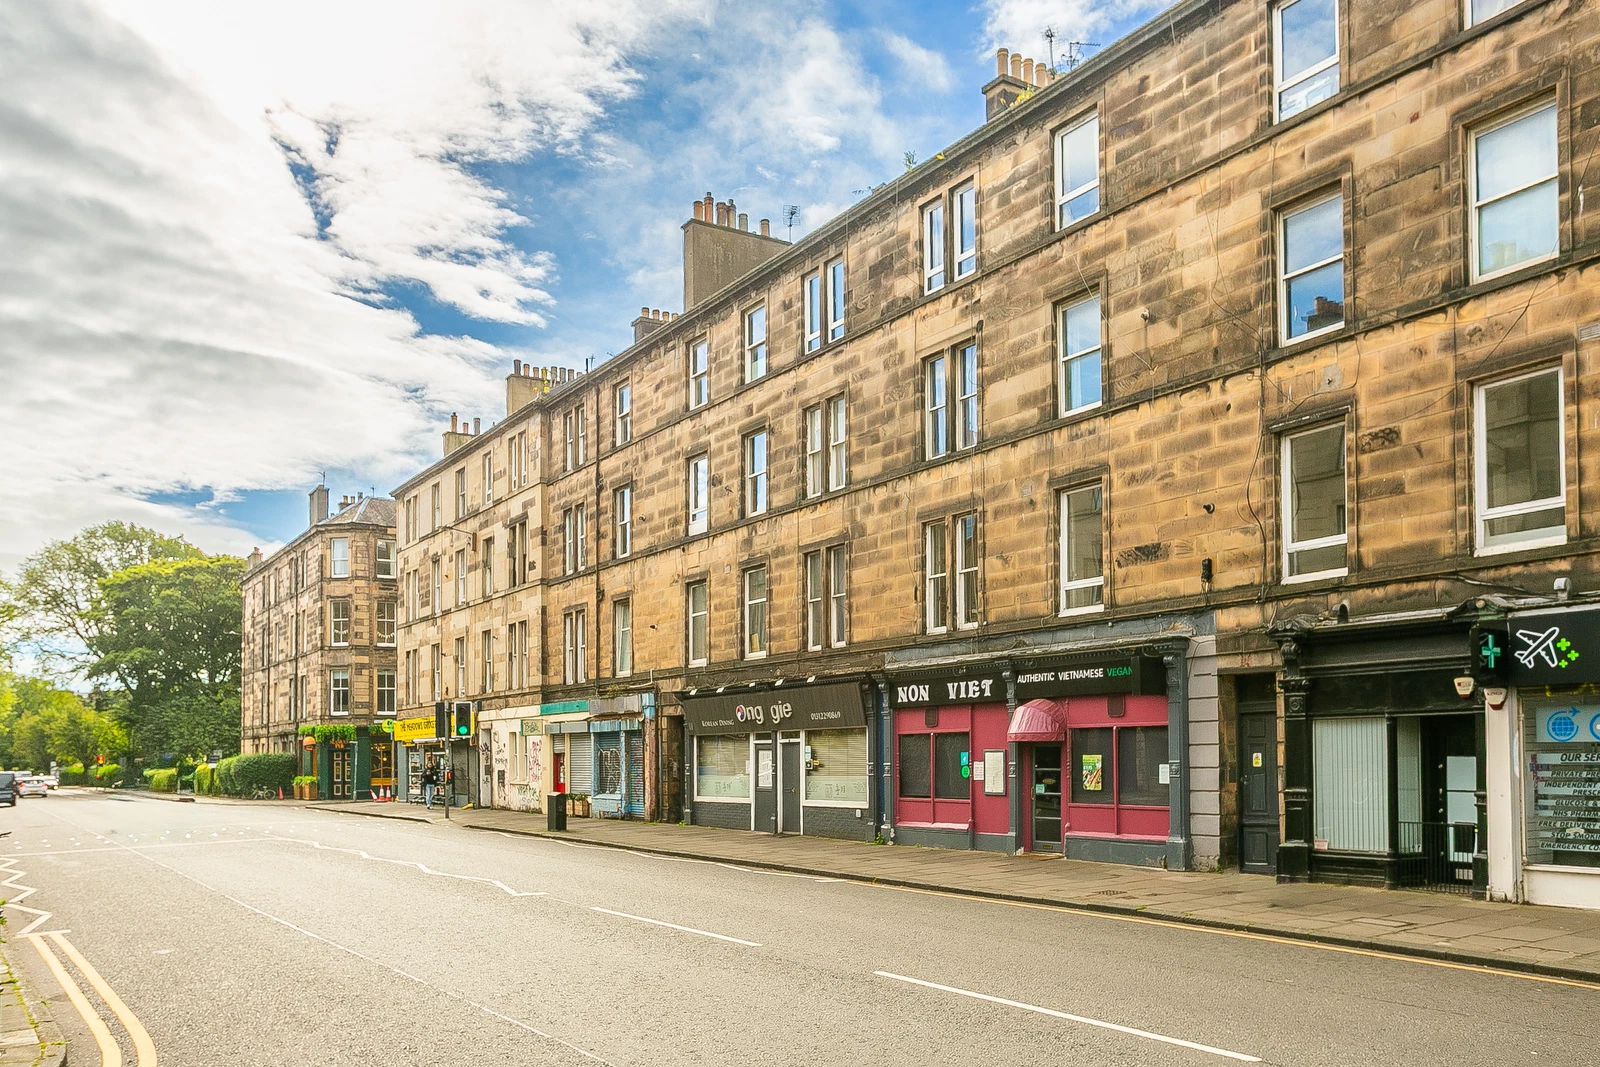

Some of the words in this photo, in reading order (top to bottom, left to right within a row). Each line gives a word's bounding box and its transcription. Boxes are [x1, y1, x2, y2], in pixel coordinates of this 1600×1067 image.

[1017, 672, 1055, 684] AUTHENTIC
[1058, 668, 1104, 681] VIETNAMESE
[897, 684, 930, 703] NON
[947, 679, 993, 700] VIET
[736, 704, 764, 725] Ong
[770, 700, 793, 724] gie
[1560, 753, 1582, 762] OUR
[1555, 799, 1590, 807] GLUCOSE
[1551, 831, 1571, 839] STOP
[1540, 842, 1587, 850] EMERGENCY
